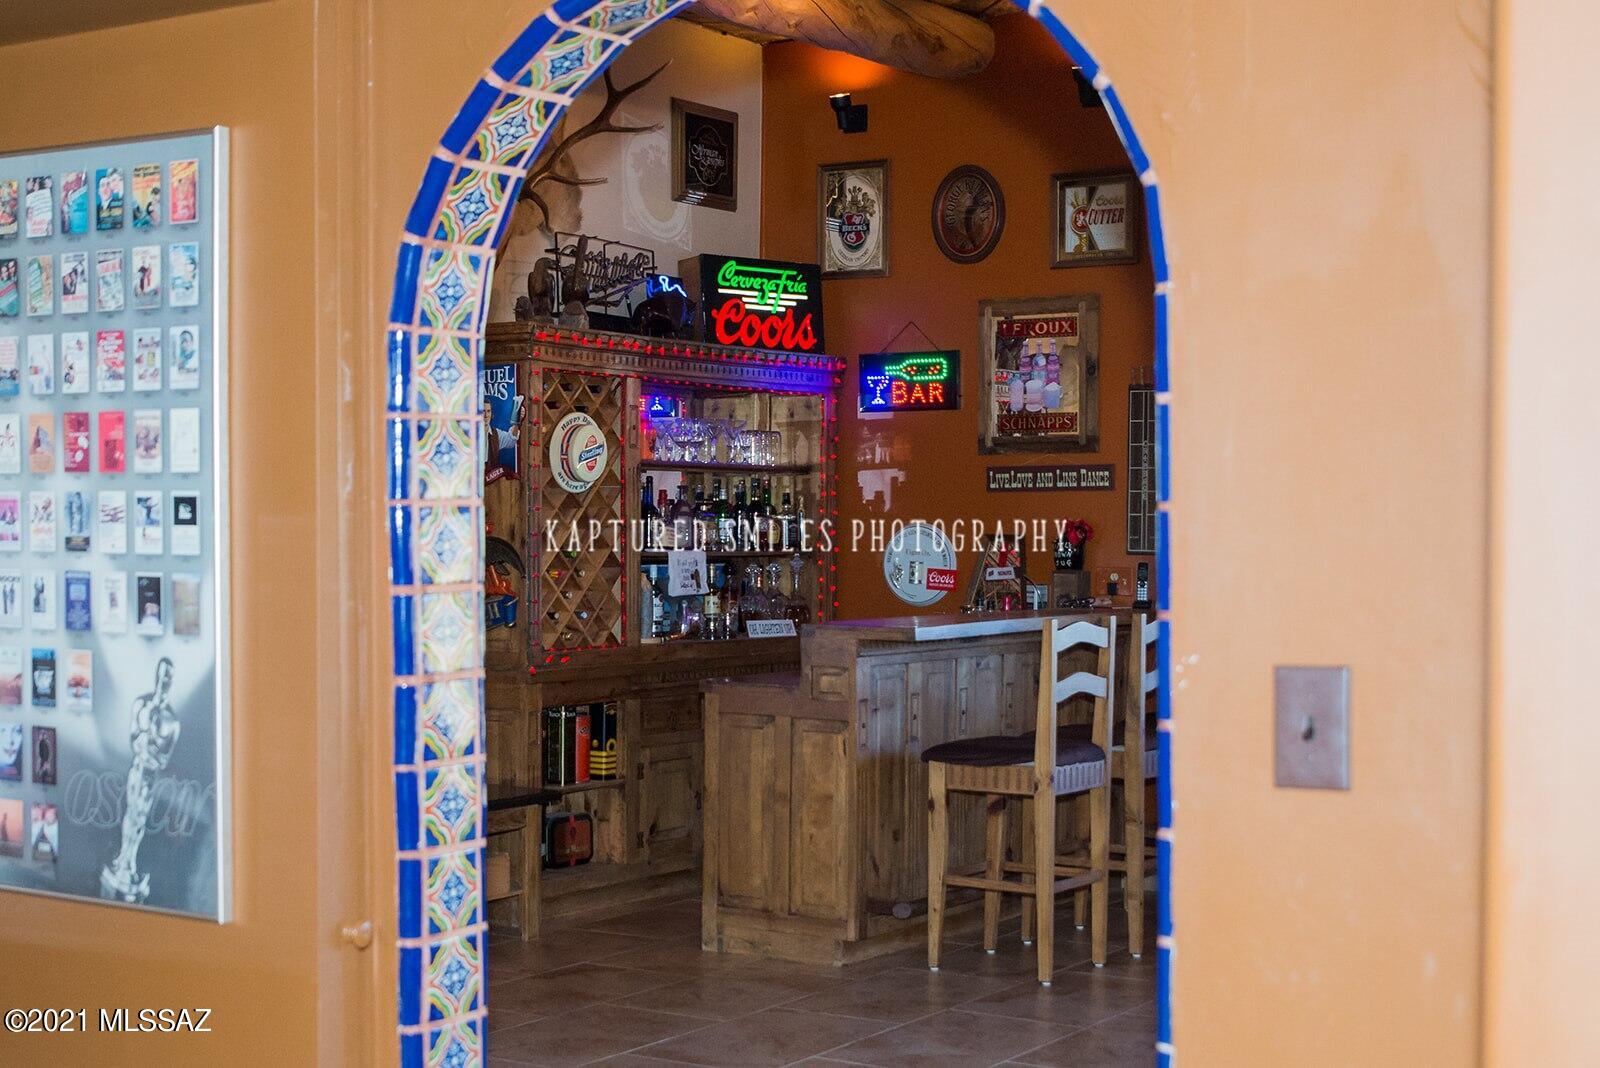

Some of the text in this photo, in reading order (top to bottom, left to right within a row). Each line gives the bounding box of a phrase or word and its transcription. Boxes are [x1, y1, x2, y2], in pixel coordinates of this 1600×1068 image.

[1089, 208, 1125, 225] CUTTER
[717, 260, 778, 305] Cerveza
[711, 298, 817, 350] Coors
[484, 366, 514, 384] UEL
[891, 381, 944, 404] BAR
[1002, 416, 1073, 430] SCHNAPPS
[1036, 472, 1054, 488] AND
[1056, 469, 1077, 488] LINE
[1080, 468, 1110, 487] DANCE
[928, 571, 957, 584] Coors
